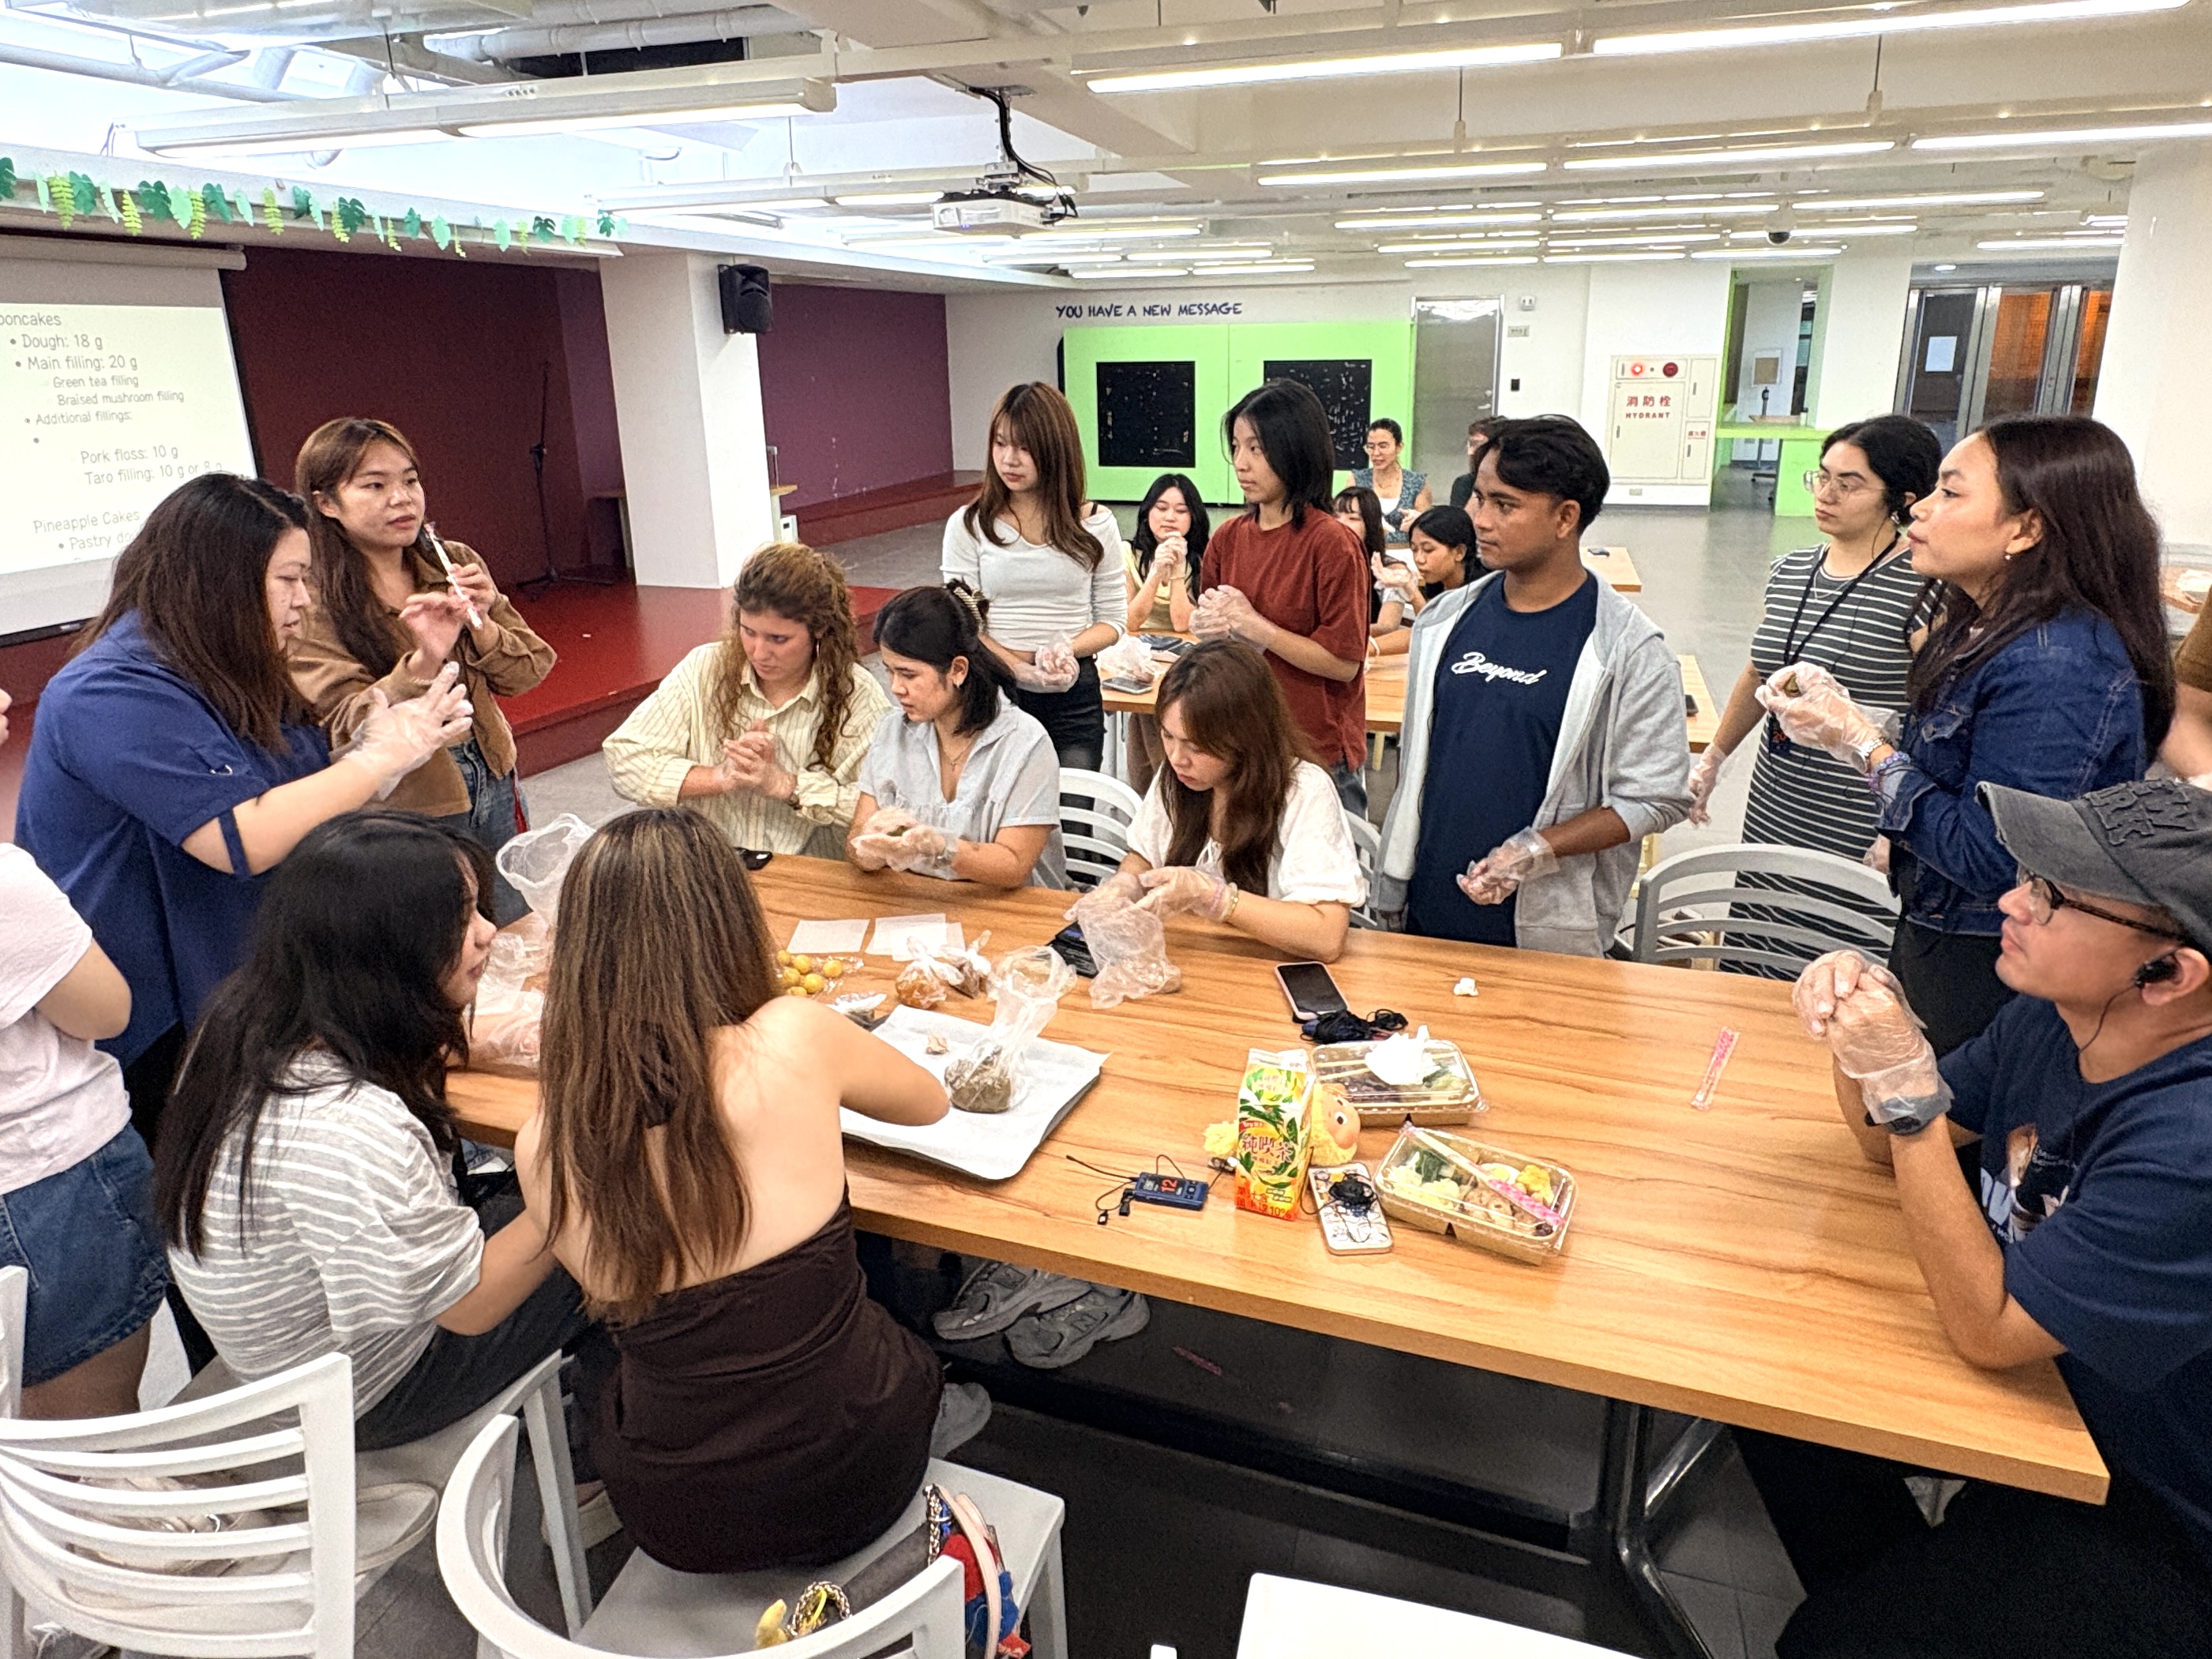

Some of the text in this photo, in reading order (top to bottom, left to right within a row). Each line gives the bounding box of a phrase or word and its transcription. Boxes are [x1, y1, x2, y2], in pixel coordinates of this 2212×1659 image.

[1056, 302, 1243, 318] YOU HAVE A NEW MESSAGE
[21, 333, 103, 351] Dough: 18 g
[28, 355, 137, 371] Main filling: 20 g
[53, 375, 139, 388] Green tea filling
[57, 391, 184, 406] Braised mushroom filling
[1626, 396, 1671, 407] 消防栓
[36, 411, 92, 425] Additional
[81, 445, 178, 464] Pork floss: 10 g
[84, 471, 113, 485] Taro
[118, 468, 155, 482] filling:
[160, 464, 172, 477] 10
[178, 466, 184, 478] g
[188, 464, 199, 474] or
[33, 511, 140, 534] Pineapple Cakes
[69, 535, 111, 550] Pastry
[1452, 652, 1547, 685] Beyond
[1160, 1178, 1178, 1192] 12
